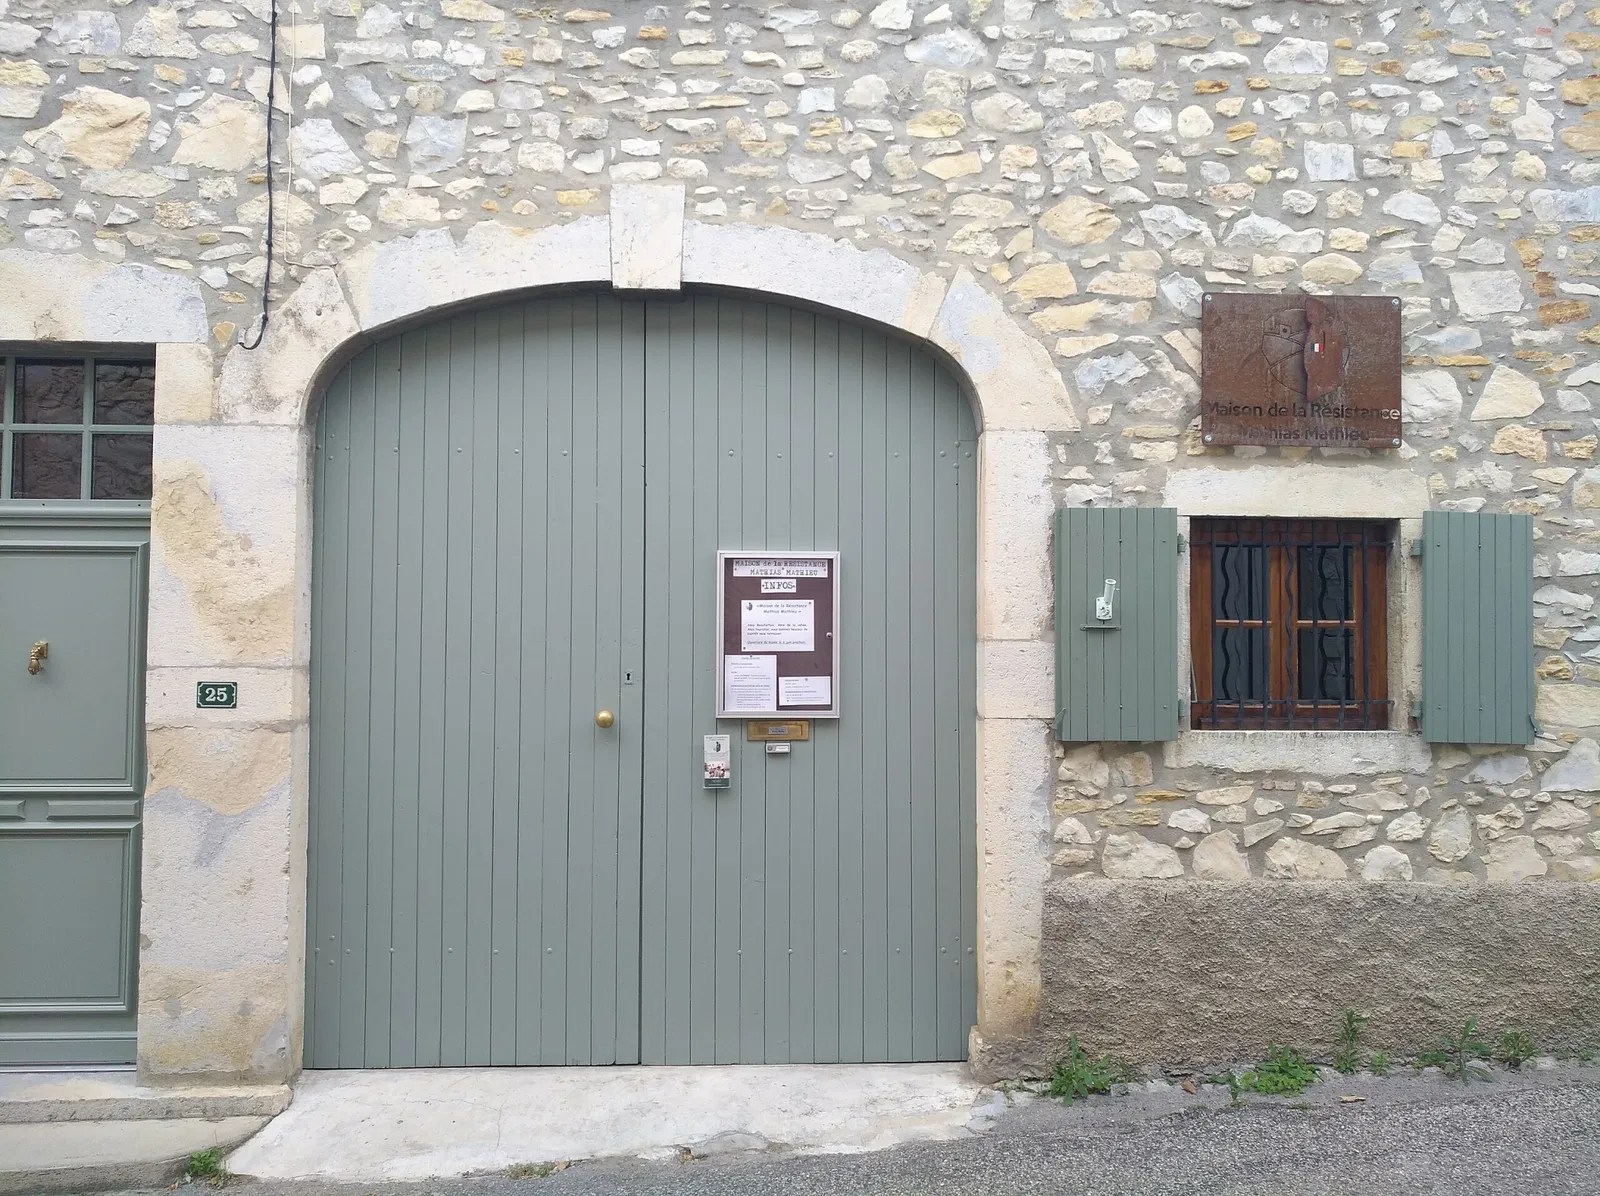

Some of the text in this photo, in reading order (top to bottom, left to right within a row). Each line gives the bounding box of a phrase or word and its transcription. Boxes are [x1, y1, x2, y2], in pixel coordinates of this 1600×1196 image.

[1207, 401, 1401, 420] Maison de la Résistance
[763, 559, 771, 567] de
[773, 559, 782, 567] la
[783, 560, 826, 568] RESISTANCE
[205, 687, 228, 702] 25
